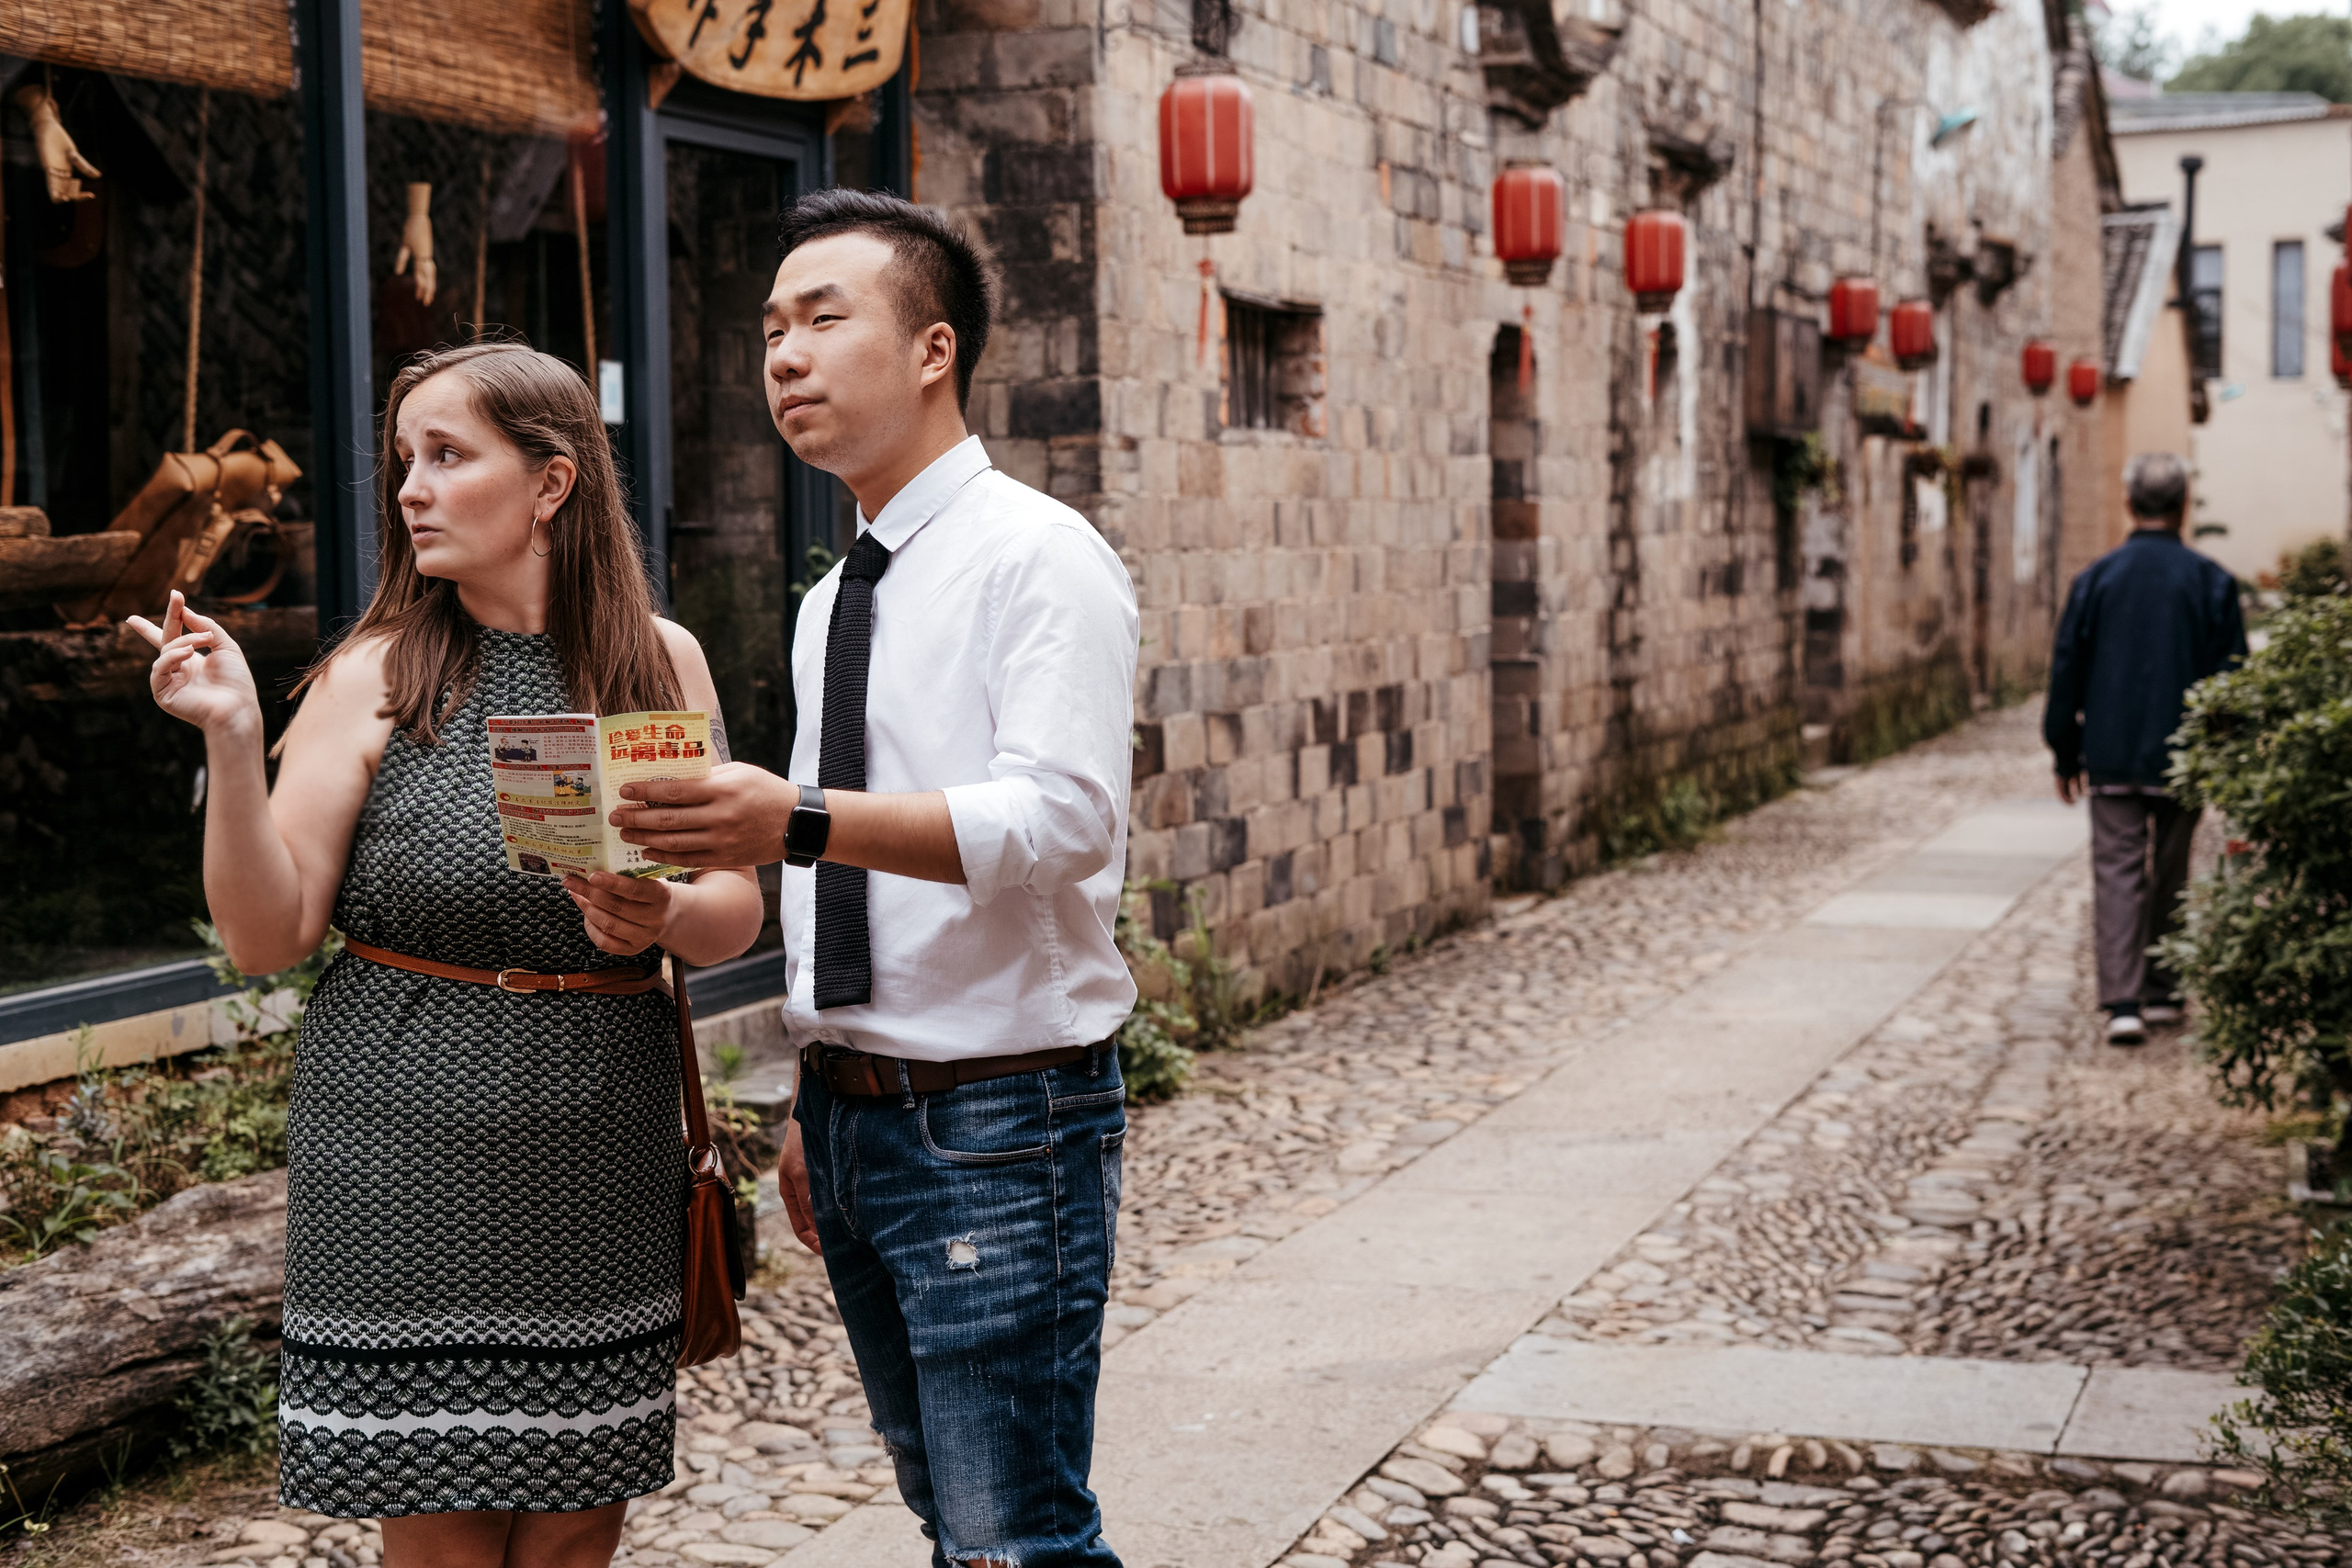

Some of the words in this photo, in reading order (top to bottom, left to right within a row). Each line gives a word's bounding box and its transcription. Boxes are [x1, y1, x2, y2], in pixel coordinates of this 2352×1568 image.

[608, 724, 685, 744] 珍爱生命
[610, 741, 707, 761] 远离毒品
